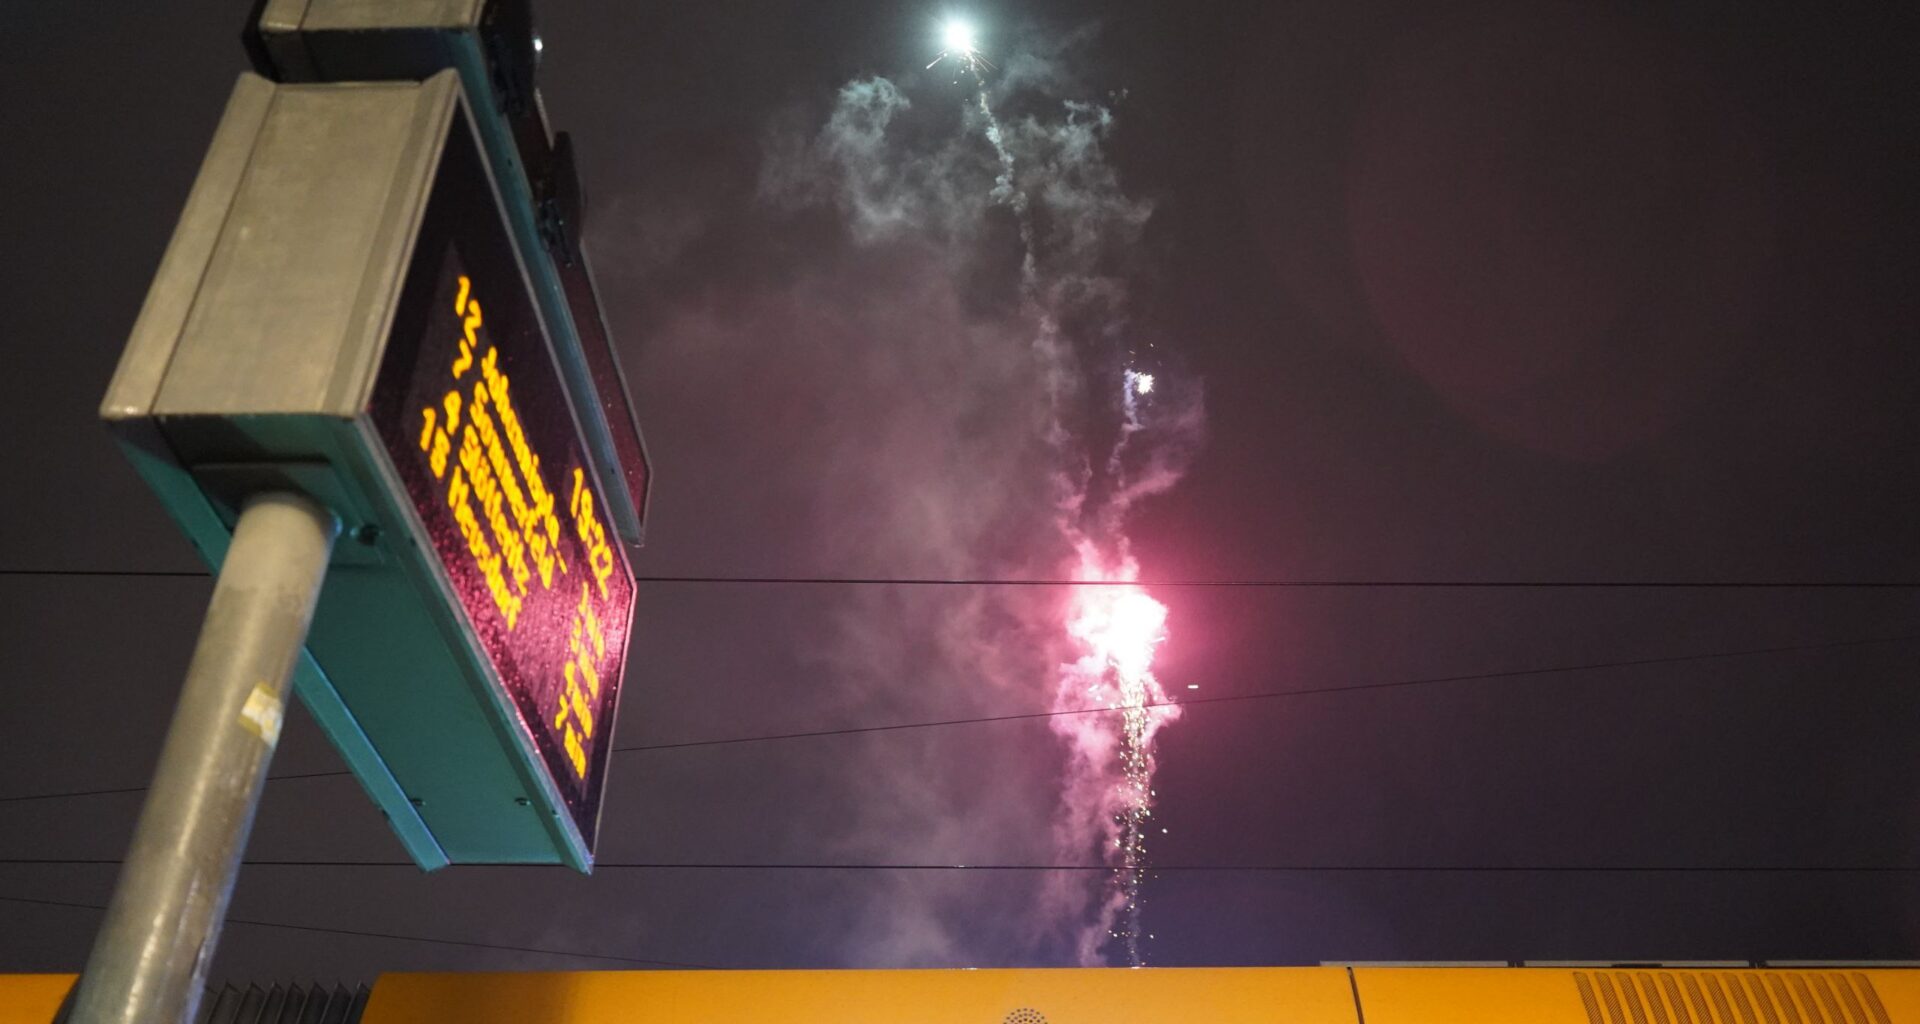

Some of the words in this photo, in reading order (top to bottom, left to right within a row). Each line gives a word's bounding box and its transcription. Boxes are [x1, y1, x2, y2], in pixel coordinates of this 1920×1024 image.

[444, 391, 462, 435] 4
[459, 424, 530, 597] Stötteritz
[572, 682, 593, 739] min
[448, 465, 522, 630] Meusdorf
[554, 695, 569, 729] 7
[563, 720, 587, 779] min
[452, 339, 473, 379] 7
[470, 381, 554, 589] Sommerfeld
[577, 642, 599, 699] min
[455, 276, 482, 347] 12
[577, 582, 589, 615] 1
[584, 600, 605, 662] min
[570, 467, 613, 600] 19:22
